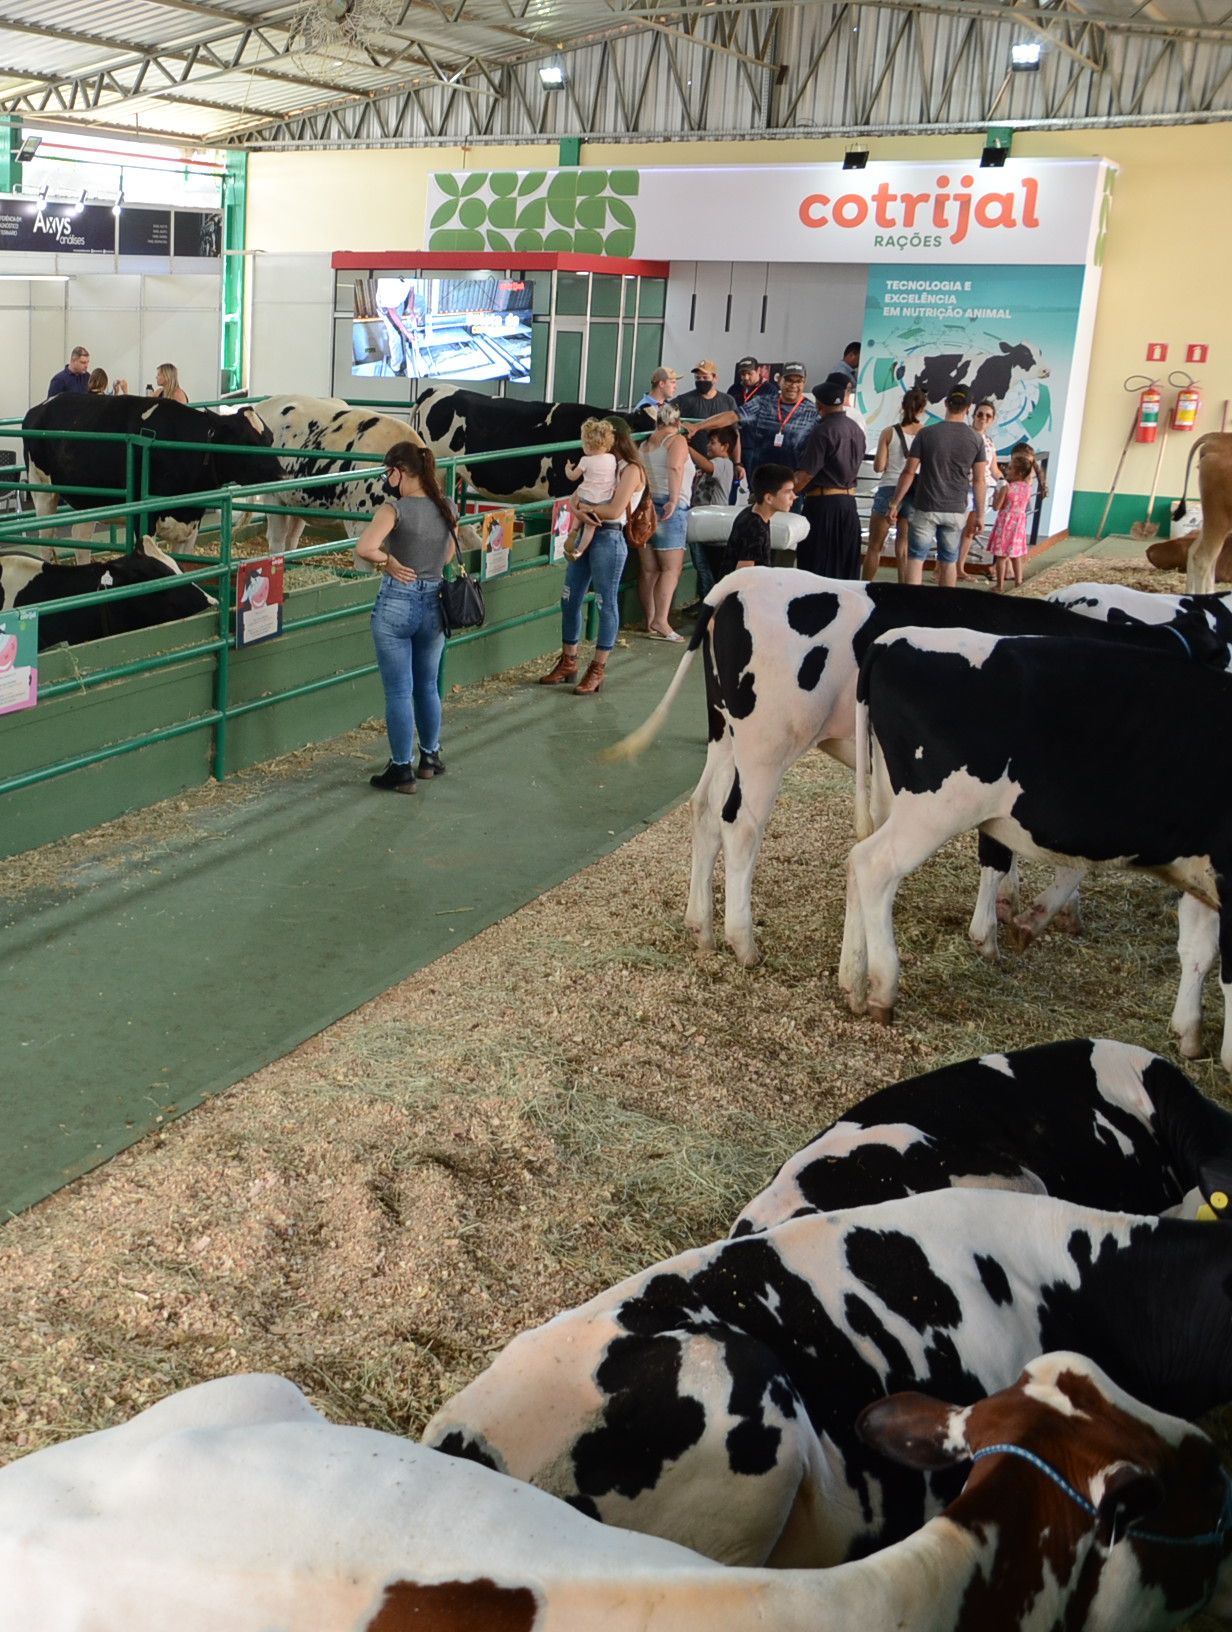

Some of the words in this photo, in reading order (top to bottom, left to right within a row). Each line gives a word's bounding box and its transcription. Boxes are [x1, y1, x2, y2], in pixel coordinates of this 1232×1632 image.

[799, 175, 1040, 245] cotrijal
[32, 210, 72, 241] Axys
[60, 234, 85, 246] análises
[874, 232, 942, 250] RAÇÕES
[886, 280, 963, 291] TECNOLOGIA
[964, 281, 972, 291] E
[884, 292, 957, 304] EXCELÊNCIA
[883, 307, 900, 316] EM
[902, 306, 963, 320] NUTRIÇÃO
[965, 308, 1012, 319] ANIMAL
